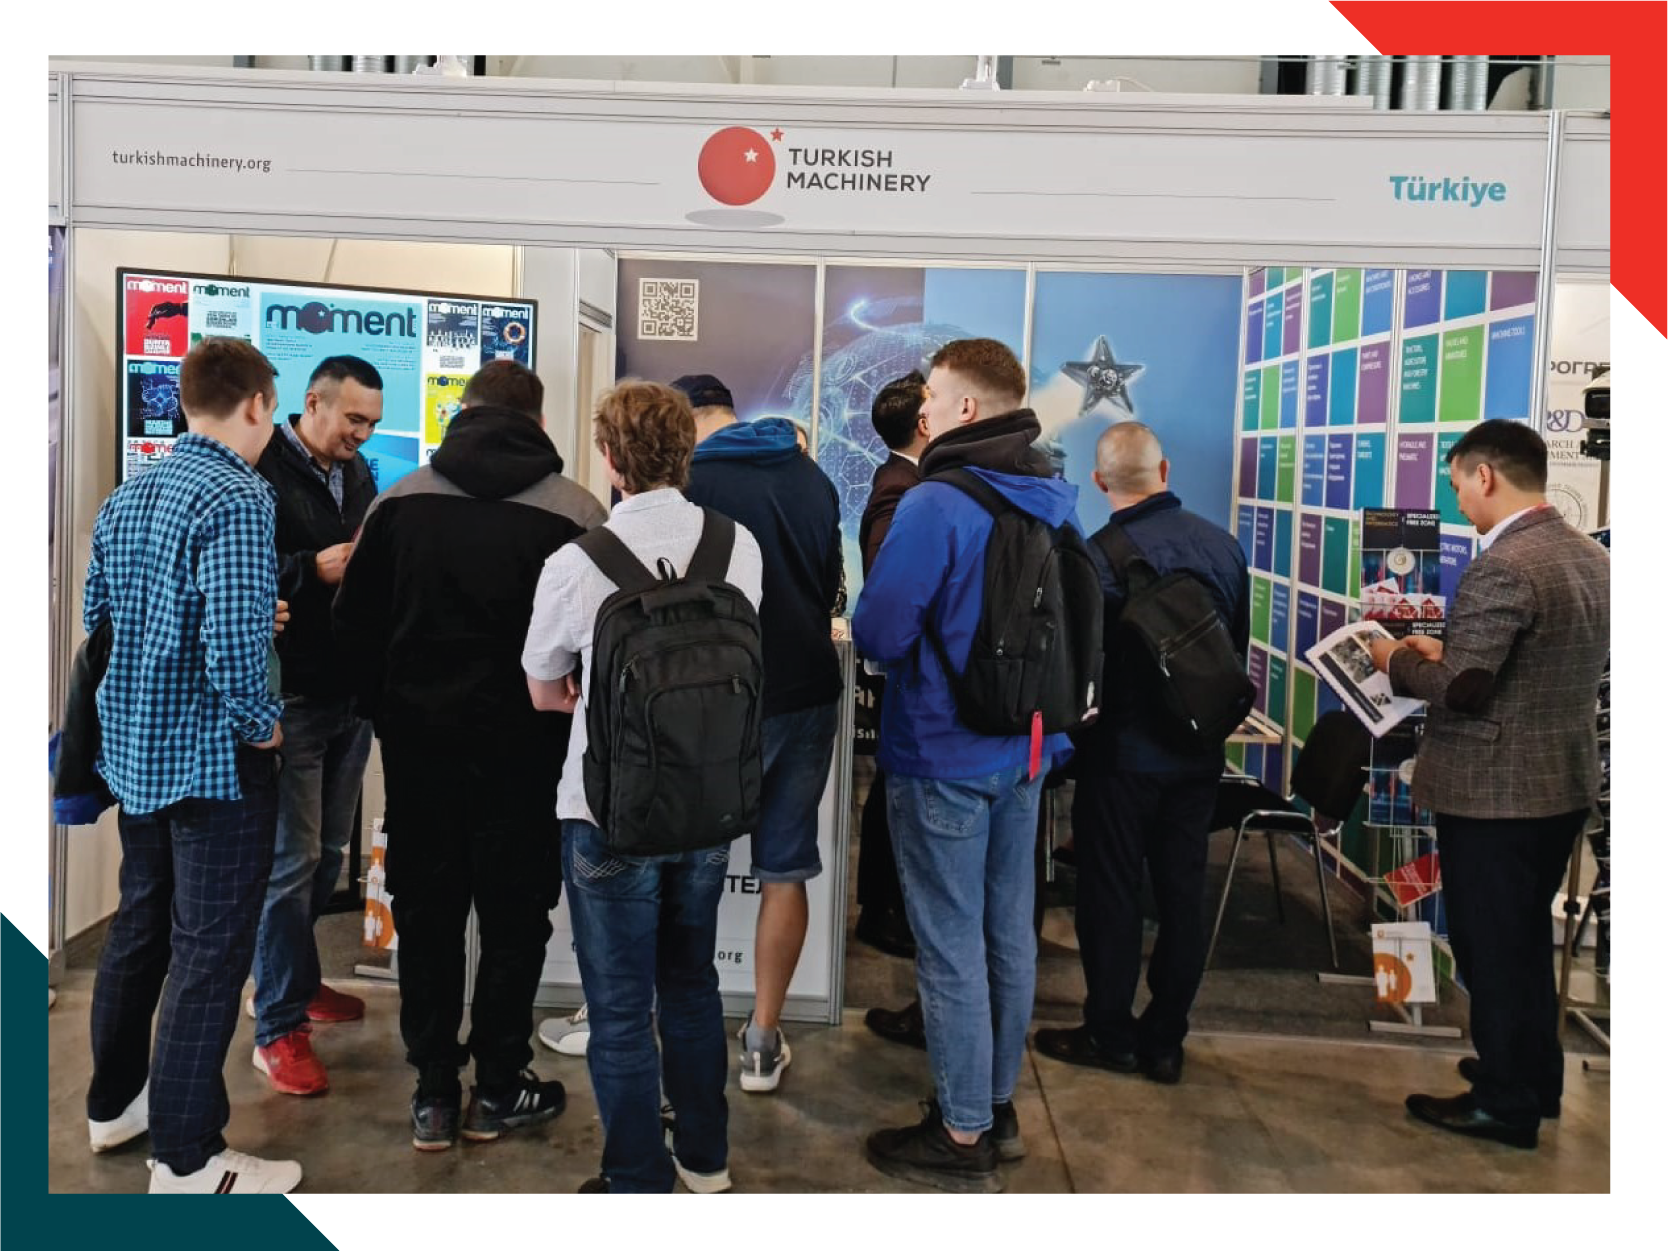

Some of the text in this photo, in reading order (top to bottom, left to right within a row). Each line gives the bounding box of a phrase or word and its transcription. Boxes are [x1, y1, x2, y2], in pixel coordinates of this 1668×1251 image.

[112, 150, 272, 173] turkishmachinery.org
[788, 148, 893, 168] TURKISH
[786, 171, 931, 193] MACHINERY
[1389, 175, 1507, 208] Türkiye
[126, 279, 188, 294] moment
[193, 283, 250, 298] moment
[429, 302, 478, 316] moment
[266, 301, 417, 338] moment
[128, 361, 181, 375] mome
[427, 375, 466, 387] mome
[717, 950, 743, 964] org
